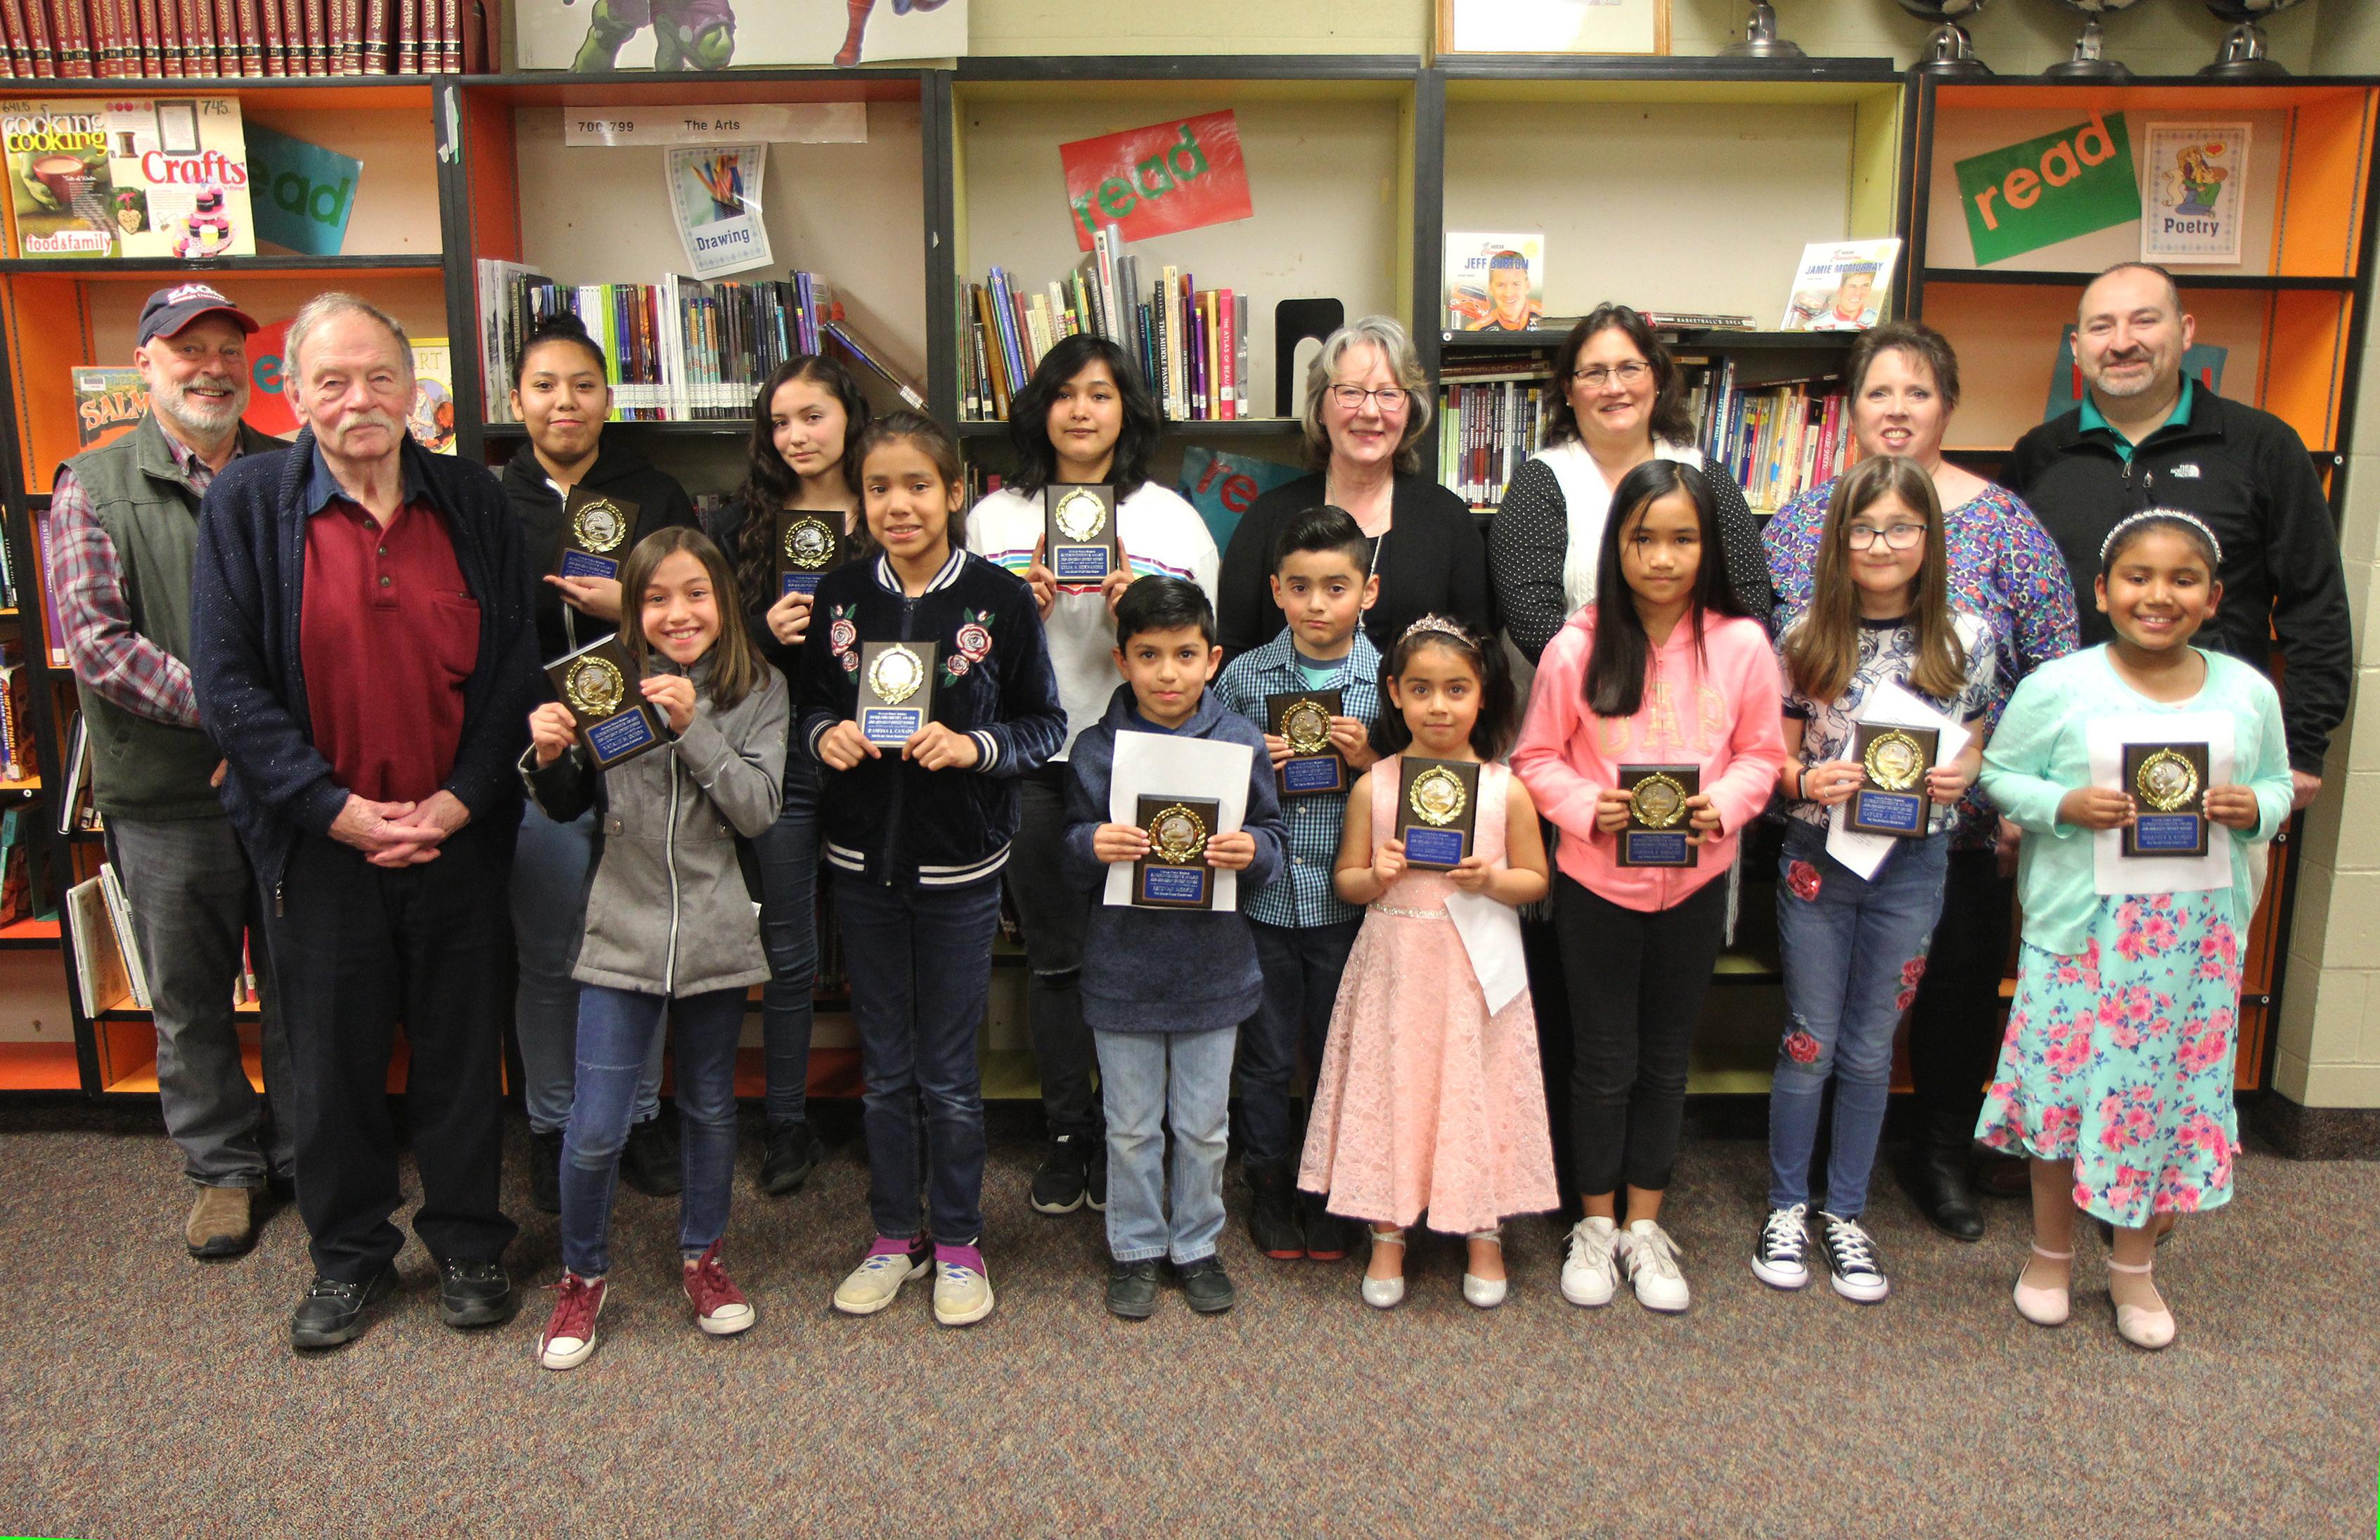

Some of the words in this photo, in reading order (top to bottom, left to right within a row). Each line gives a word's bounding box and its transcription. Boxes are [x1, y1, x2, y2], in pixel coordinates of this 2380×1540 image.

[8, 123, 108, 156] cooking
[610, 122, 633, 132] 799
[685, 120, 707, 131] The
[715, 120, 740, 131] Arts
[142, 150, 247, 184] Crafts
[1071, 124, 1209, 233] read
[1974, 108, 2116, 231] read
[246, 156, 349, 226] ead
[696, 228, 750, 252] Drawing
[2163, 218, 2220, 237] Poetry
[1465, 258, 1486, 269] JEFF
[1491, 258, 1529, 270] BURTON
[1806, 265, 1832, 275] JAMIE
[1834, 262, 1884, 273] MCMURRAY
[1197, 457, 1259, 513] re
[4, 695, 12, 725] HOTTER
